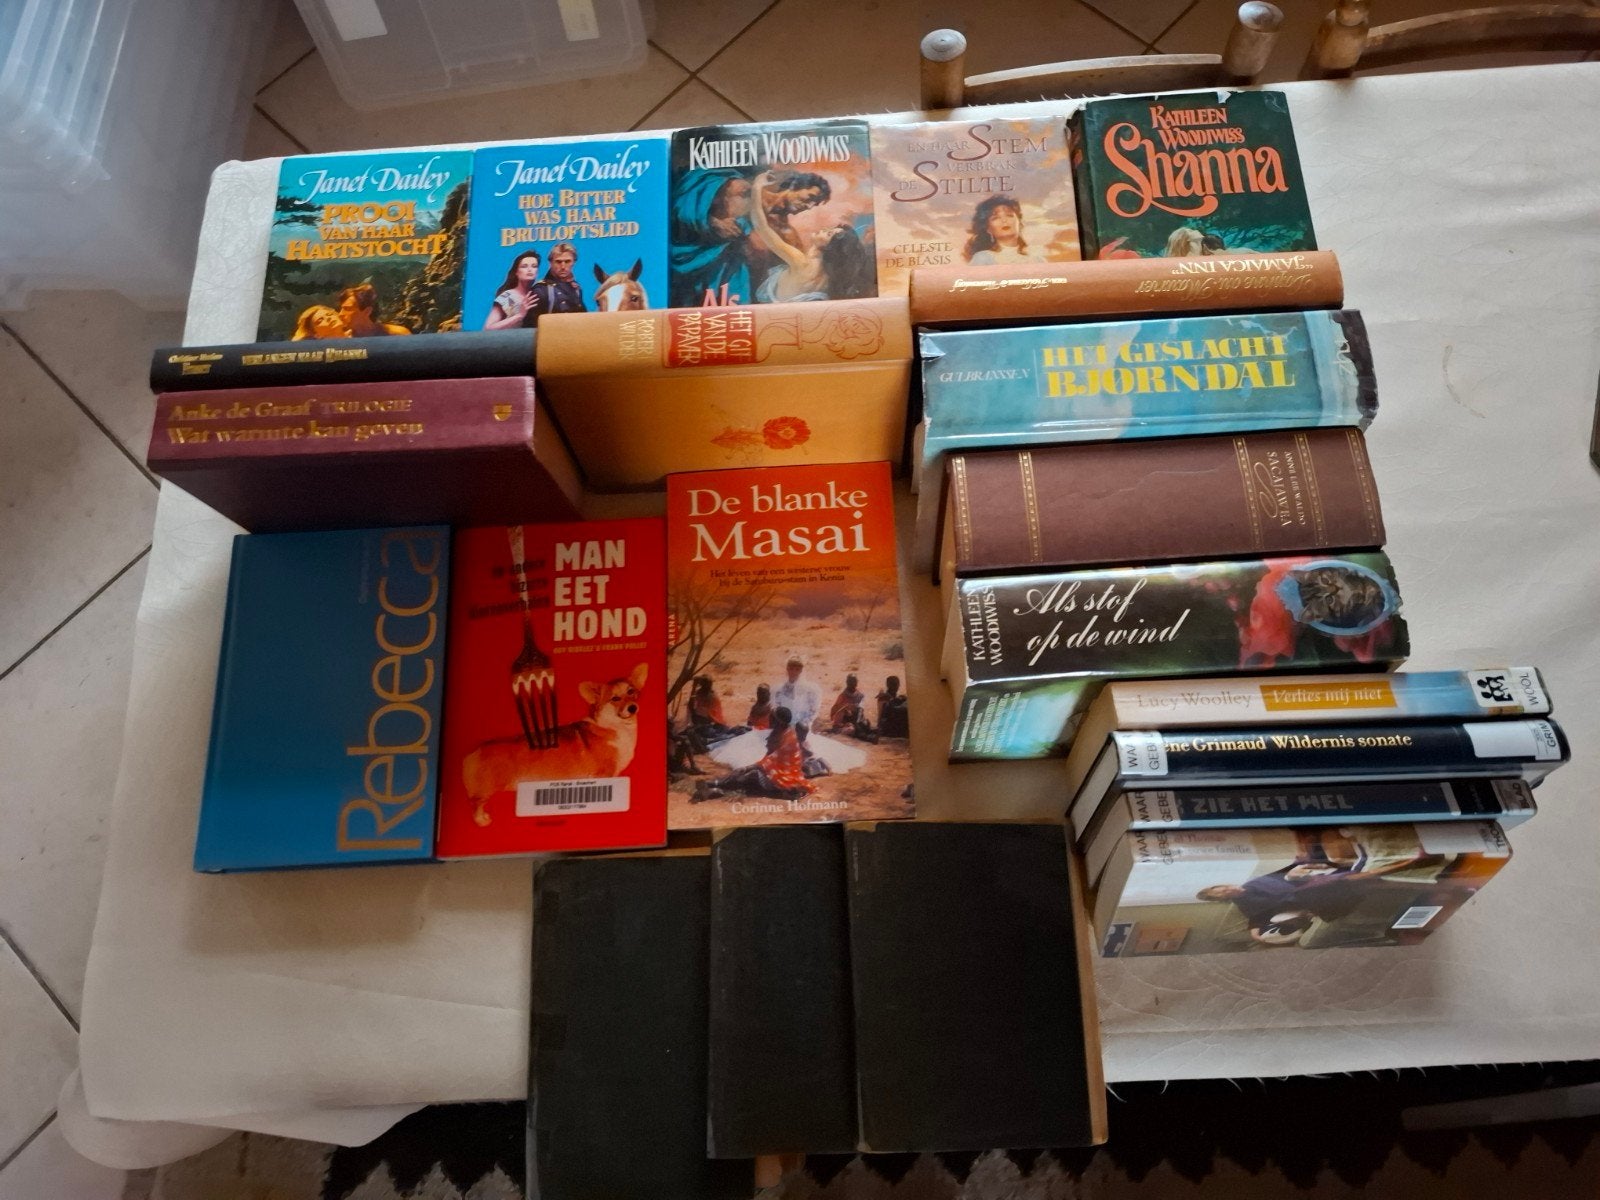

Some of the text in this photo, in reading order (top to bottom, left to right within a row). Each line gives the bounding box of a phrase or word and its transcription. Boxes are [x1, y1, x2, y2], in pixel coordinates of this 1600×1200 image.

[1150, 106, 1228, 130] KATHLEEN
[689, 133, 851, 171] KATHLEEN WOODIWISS
[931, 141, 970, 152] HAAR
[947, 124, 1048, 162] STEM
[1158, 127, 1246, 151] WOODIWISS
[294, 155, 451, 205] Janet Dailey
[494, 144, 650, 197] Janet Dailey
[946, 160, 1017, 173] VERBRAK
[1104, 122, 1289, 218] Shanna
[890, 160, 1014, 203] DE STILTE
[321, 200, 417, 225] PROOI
[518, 189, 626, 210] HOE BITTER
[524, 207, 617, 226] WAS HAAR
[318, 223, 416, 241] VAN HAAR
[501, 221, 640, 247] BRUILOFTSLIED
[284, 233, 448, 261] HARTSTOCHT
[893, 242, 953, 255] CELESTE
[885, 254, 952, 269] DE BLASIS
[703, 313, 728, 339] VAN
[729, 310, 752, 335] HET
[619, 320, 637, 361] WILDER
[638, 318, 655, 360] ROBERT
[677, 311, 702, 366] PAPAVER
[1042, 335, 1288, 367] HET GESLACHT
[167, 399, 414, 421] Anke de Graaf TRILOGIE
[168, 420, 424, 444] Wat warmte kan geven
[687, 481, 869, 517] De blanke
[689, 510, 871, 562] Masai
[554, 539, 626, 572] MAN
[554, 574, 612, 608] EET
[1013, 577, 1149, 623] Als stof
[553, 607, 648, 642] HOND
[967, 588, 985, 661] KATHLEEN
[1026, 608, 1191, 667] op de wind
[336, 529, 443, 852] Rebecca
[1138, 690, 1252, 712] Lucy Woolley
[1272, 687, 1383, 704] Verlies mij niet
[1520, 672, 1539, 706] WOOL
[1192, 736, 1267, 752] Grimaud
[1270, 734, 1355, 750] Wildernis
[1357, 733, 1412, 747] sonate
[1539, 722, 1556, 748] GRIM
[731, 798, 849, 815] Corinne Hofmann
[1193, 797, 1234, 814] ZIE
[1242, 795, 1289, 813] HET
